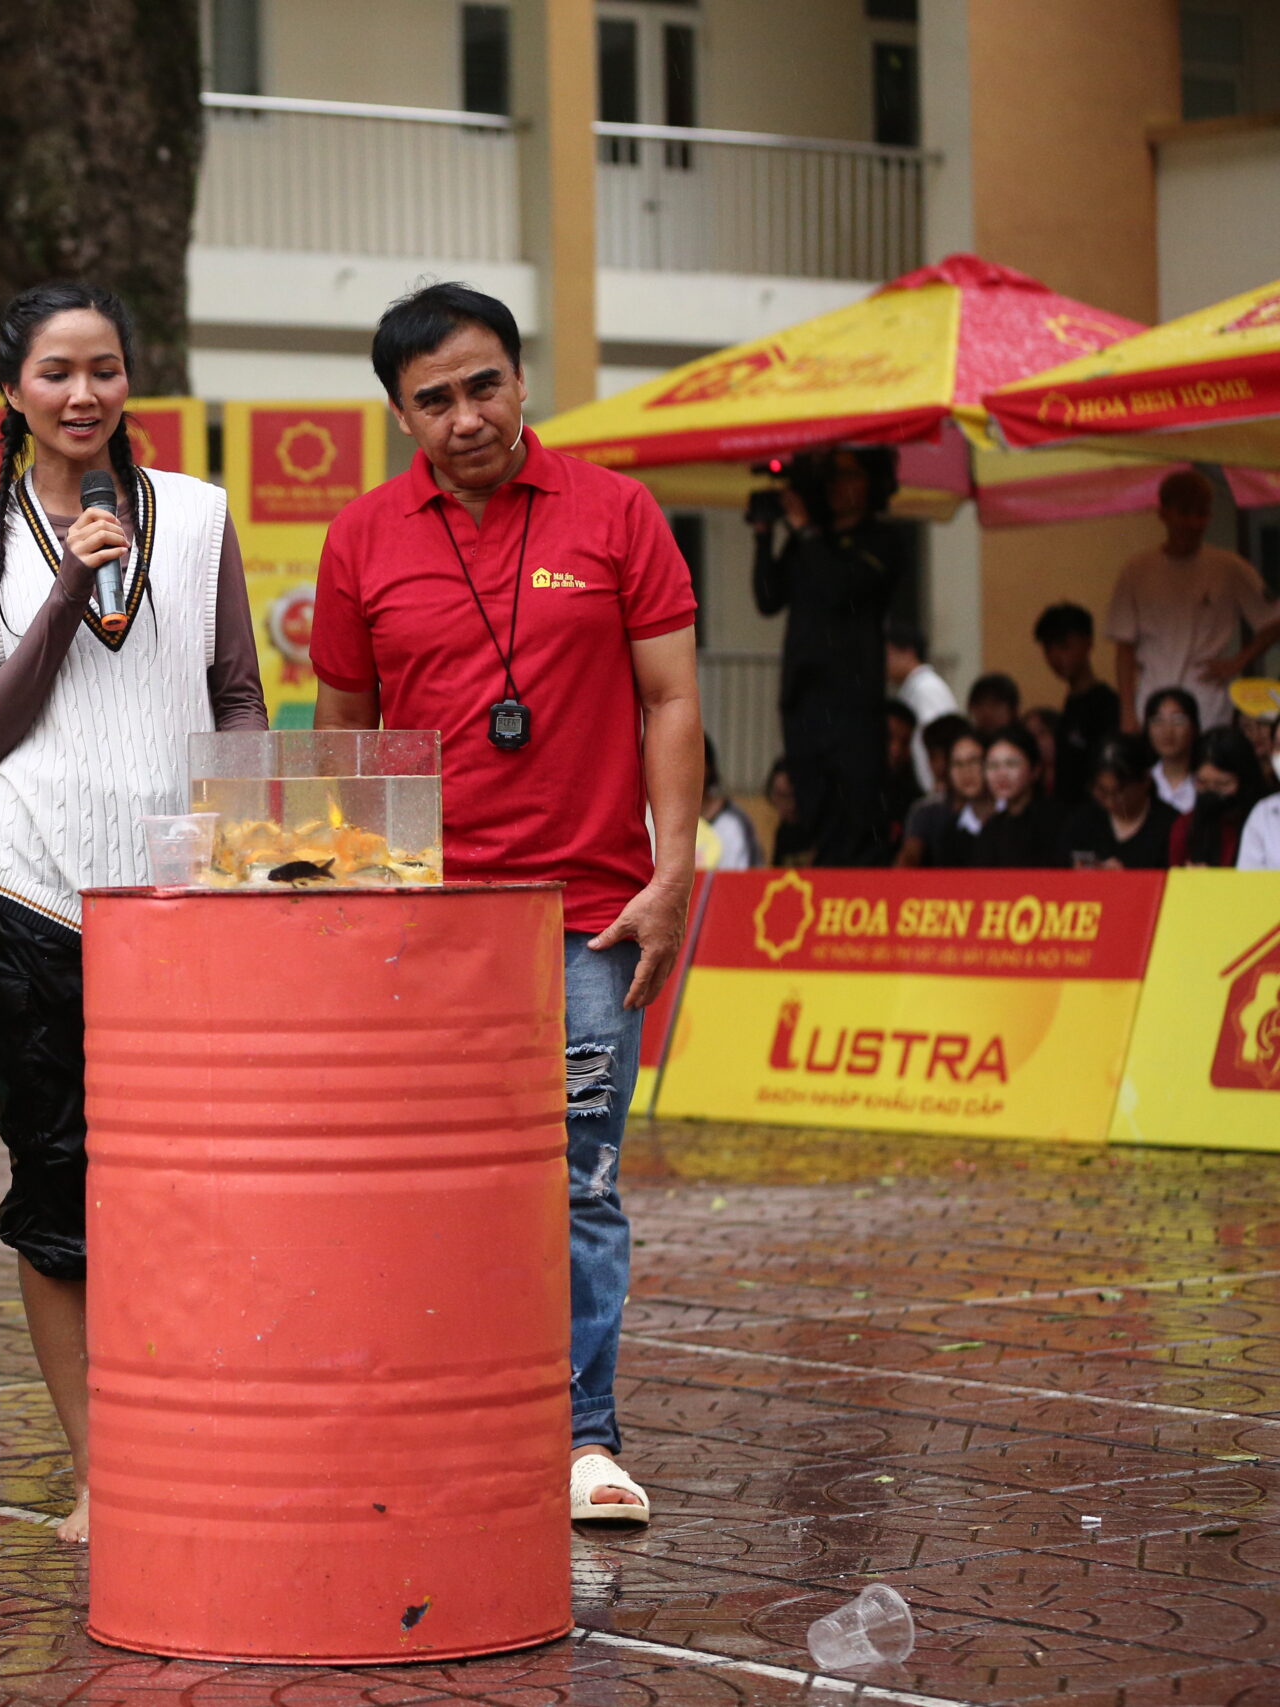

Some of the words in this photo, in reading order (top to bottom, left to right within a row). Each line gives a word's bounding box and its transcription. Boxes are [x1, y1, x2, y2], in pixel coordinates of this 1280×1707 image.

[1077, 397, 1127, 422] HOA
[816, 898, 889, 936] HOA
[897, 899, 974, 938] SEN
[979, 895, 1102, 945] HOME
[769, 998, 1008, 1084] LUSTRA
